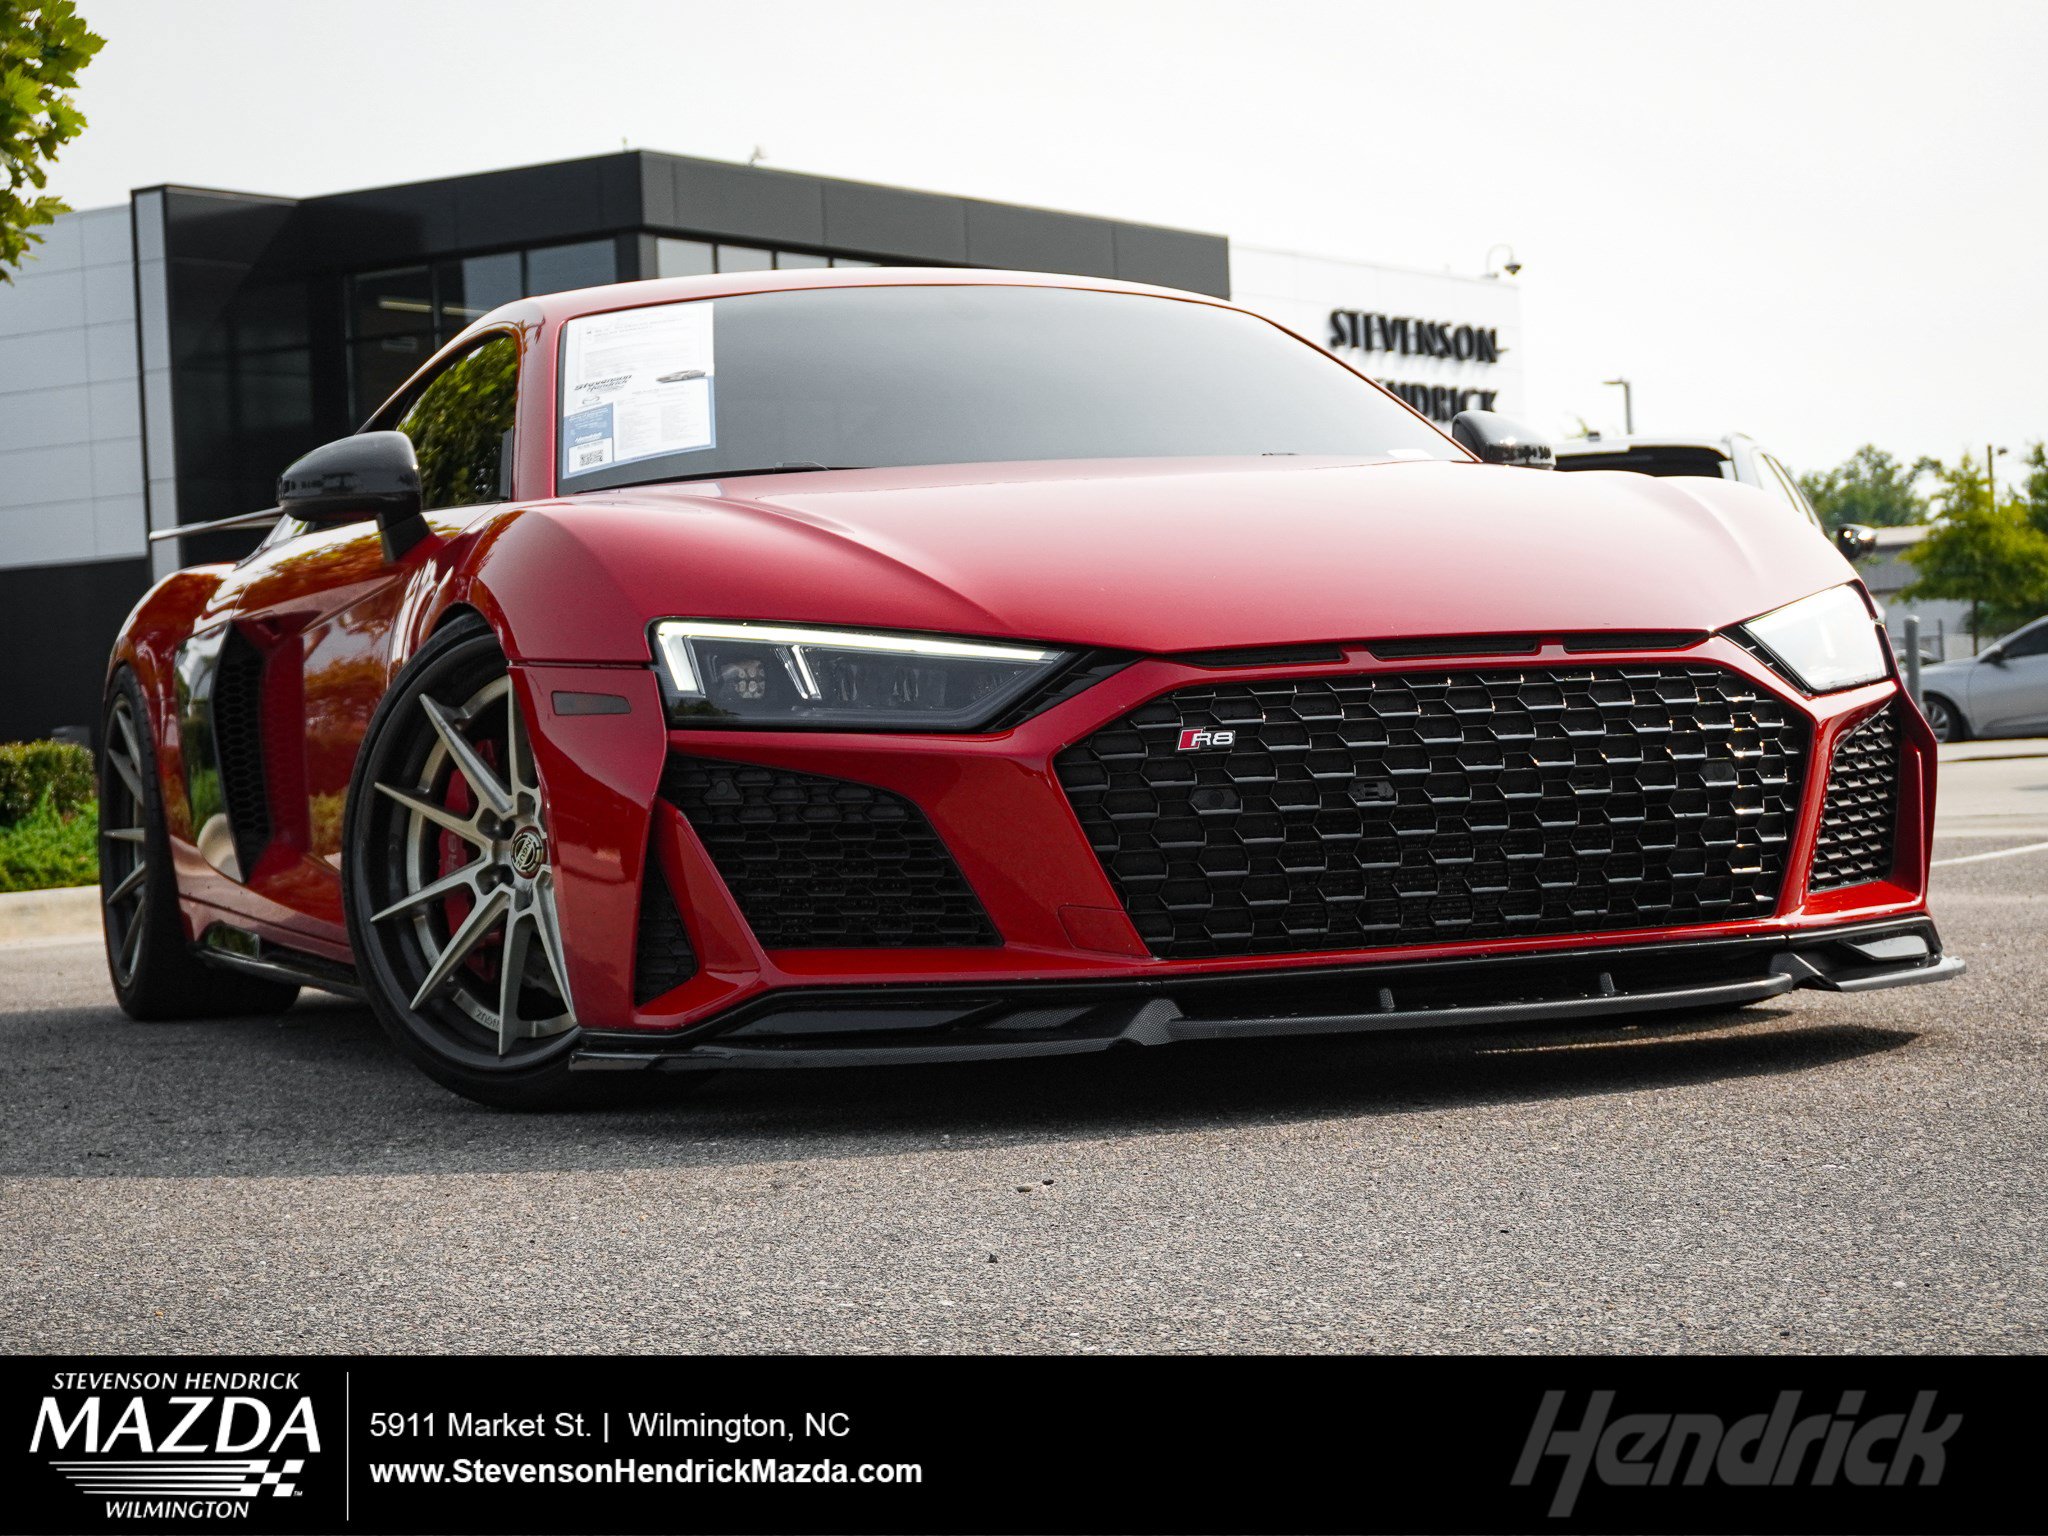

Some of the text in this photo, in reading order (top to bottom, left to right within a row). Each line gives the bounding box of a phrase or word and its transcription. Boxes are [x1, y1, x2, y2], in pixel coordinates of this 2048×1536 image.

[1329, 307, 1498, 363] STEVENSON
[1373, 377, 1498, 422] NDRICK
[1190, 731, 1234, 747] R8
